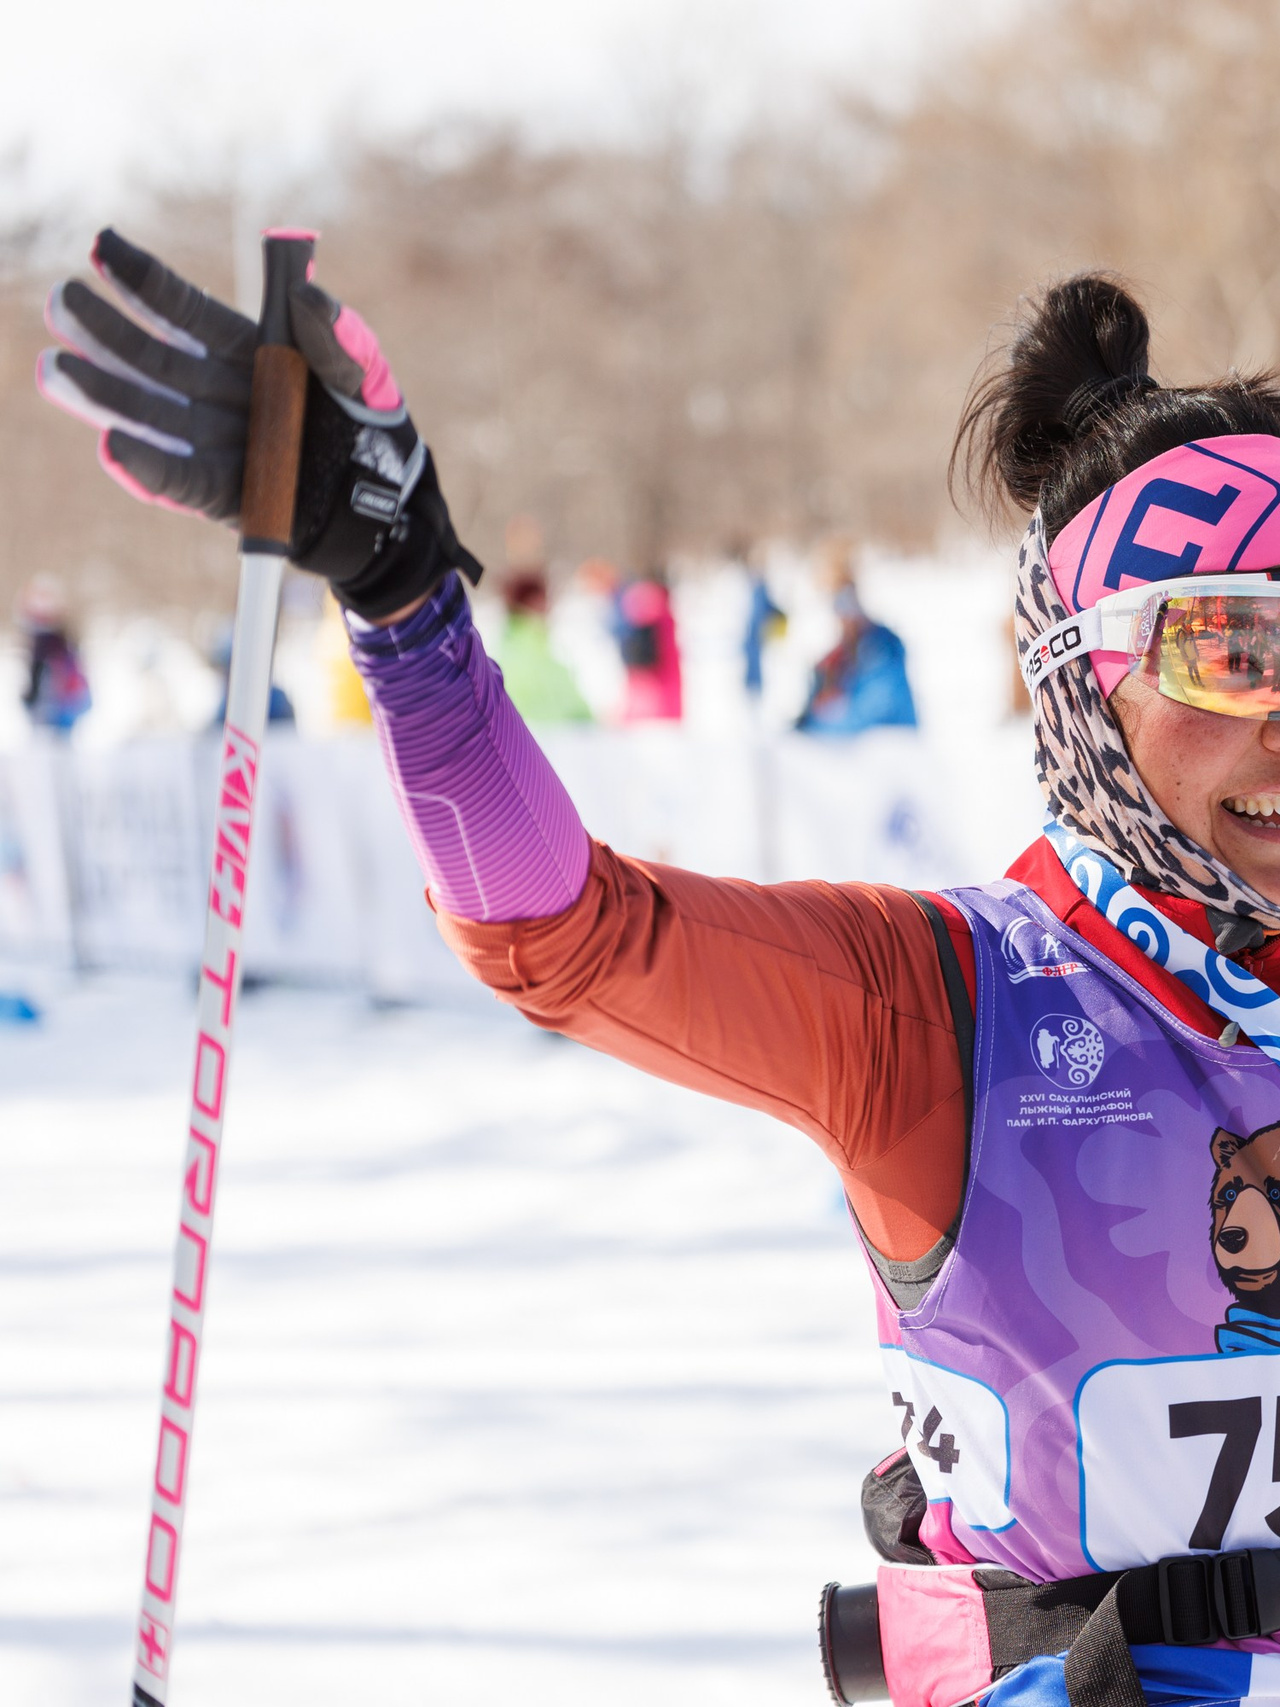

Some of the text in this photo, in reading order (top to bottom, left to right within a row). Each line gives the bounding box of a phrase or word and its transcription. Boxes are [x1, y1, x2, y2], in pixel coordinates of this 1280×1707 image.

[1019, 1088, 1132, 1104] XXVI САХАЛИНСКИЙ
[1019, 1102, 1133, 1115] ЛЫЖНЫЙ МАРАФОН
[1006, 1118, 1034, 1128] ПАМ.
[1061, 1111, 1154, 1127] ФАРХУТДИНОВА
[145, 950, 236, 1604] TORNADO
